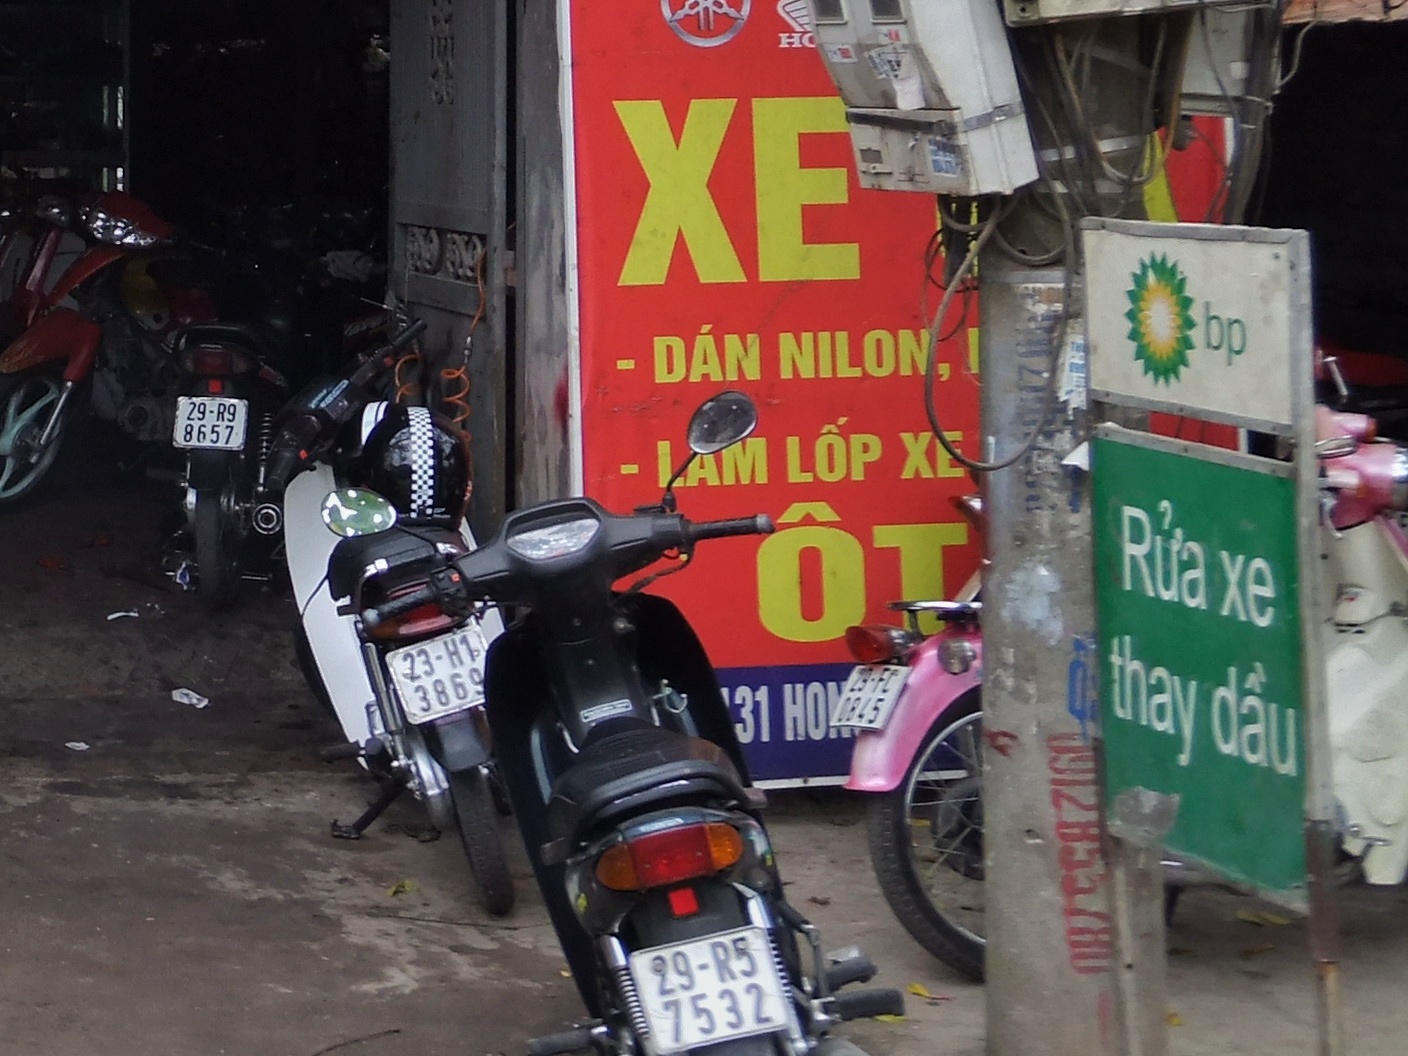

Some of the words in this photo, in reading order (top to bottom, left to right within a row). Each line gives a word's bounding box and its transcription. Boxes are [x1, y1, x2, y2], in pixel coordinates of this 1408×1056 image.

[612, 97, 861, 287] XE
[653, 323, 761, 384] DÁN
[779, 328, 952, 384] NILON,
[1203, 300, 1248, 366] bp
[183, 424, 234, 445] 8657
[186, 401, 237, 423] 29-R9
[786, 416, 883, 484] LỐP
[899, 430, 966, 480] XE
[1220, 550, 1276, 628] xe
[402, 634, 477, 682] 23-H1
[1109, 635, 1198, 768] thay
[650, 936, 758, 997] 29-R5
[662, 981, 773, 1044] 7532
